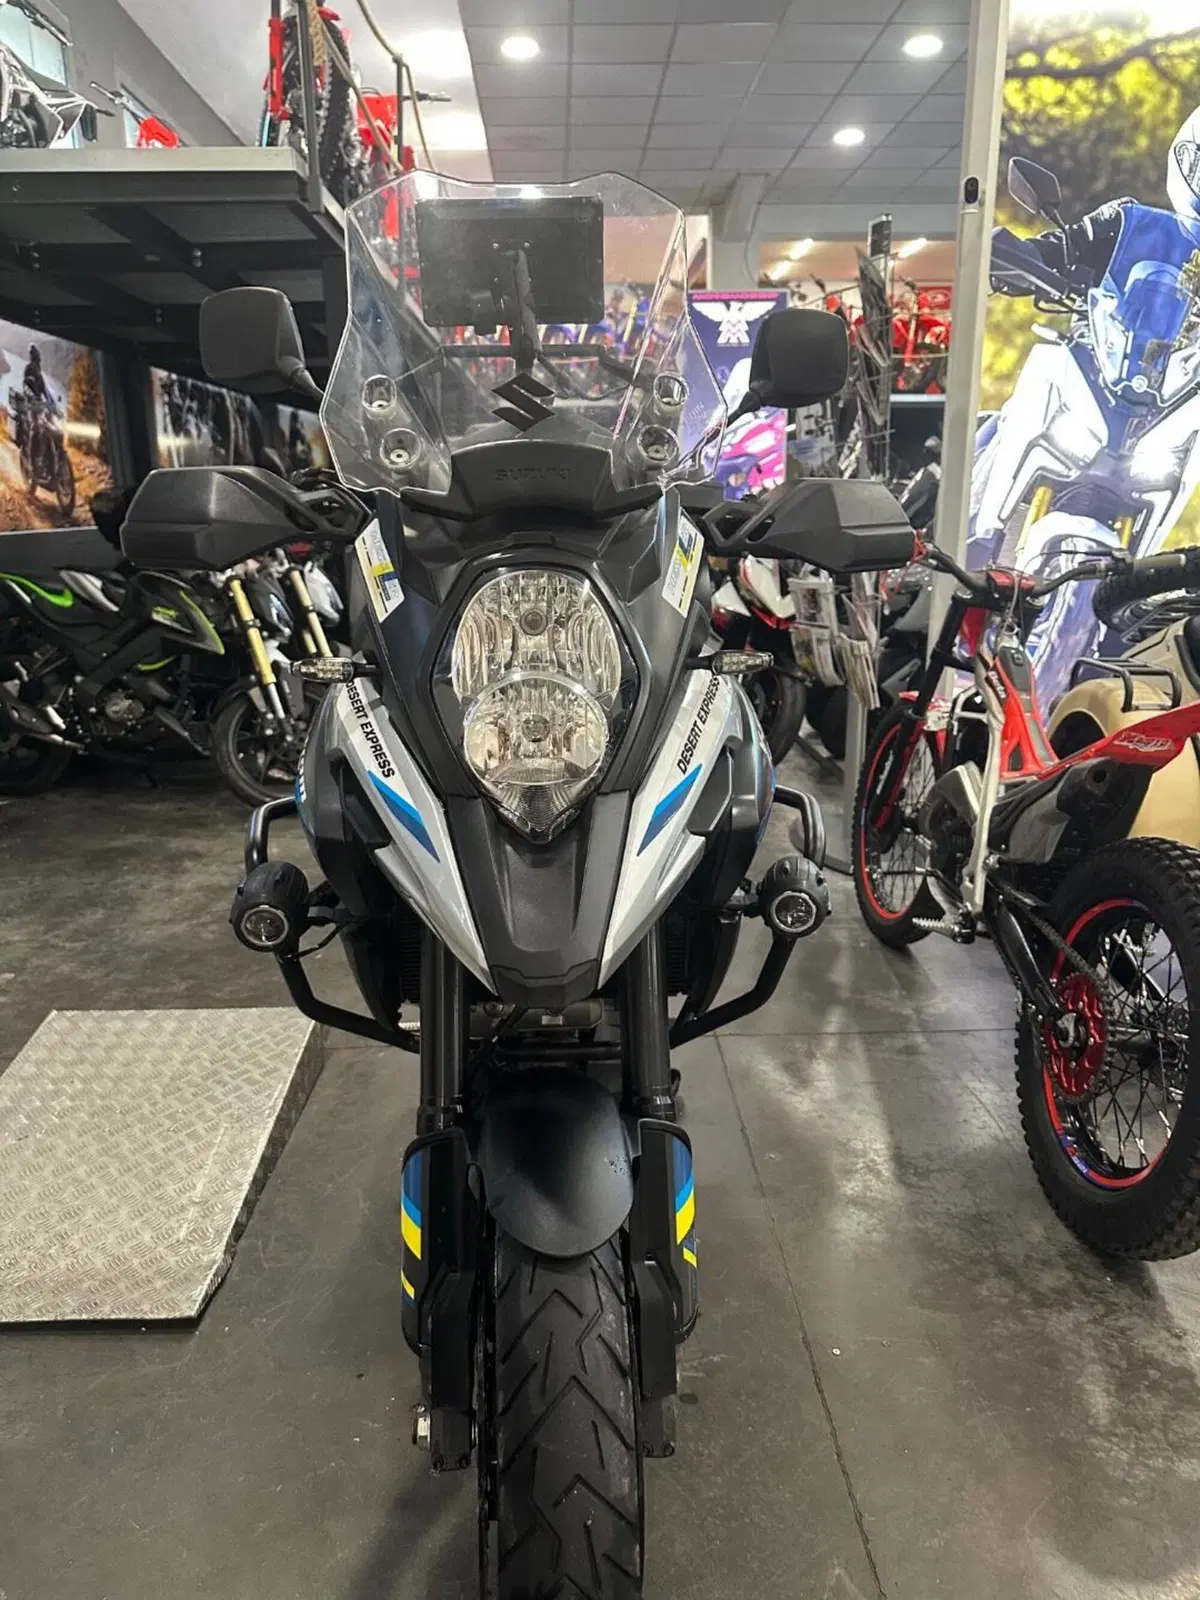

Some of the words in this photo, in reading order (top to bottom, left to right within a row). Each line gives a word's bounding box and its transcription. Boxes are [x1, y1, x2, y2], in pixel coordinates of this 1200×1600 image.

[494, 467, 571, 481] SUZUKI
[345, 680, 369, 720] DESERT
[360, 721, 395, 779] EXPRESS
[677, 719, 702, 775] DESERT
[697, 677, 720, 725] EXPRESS
